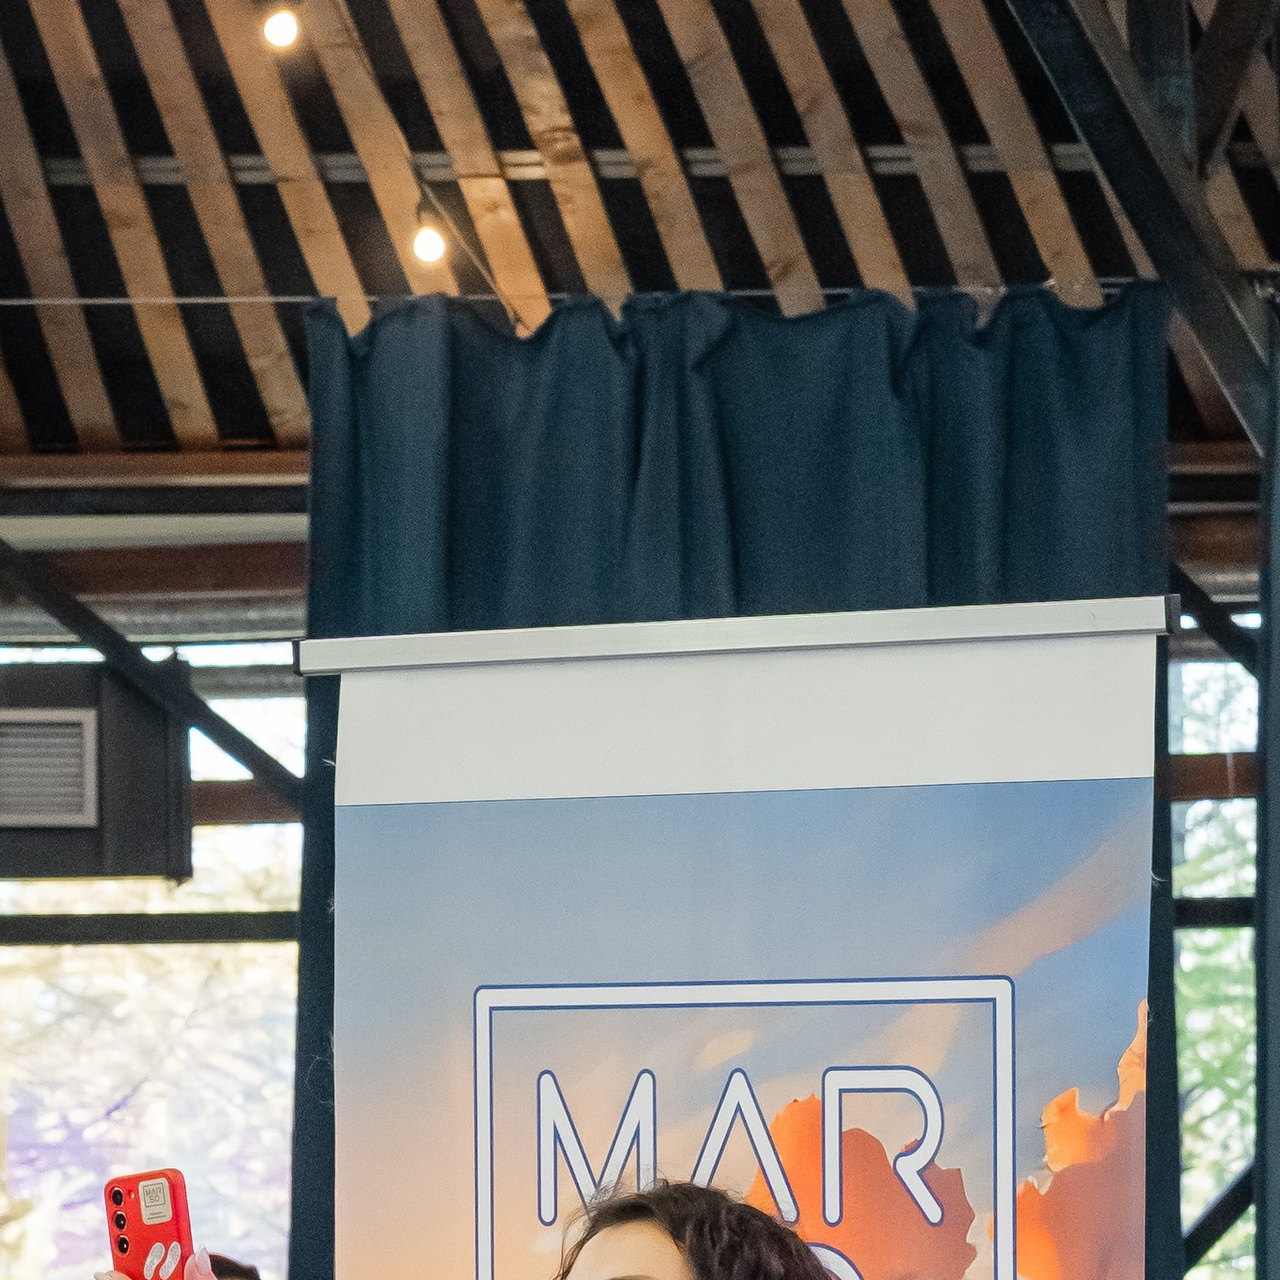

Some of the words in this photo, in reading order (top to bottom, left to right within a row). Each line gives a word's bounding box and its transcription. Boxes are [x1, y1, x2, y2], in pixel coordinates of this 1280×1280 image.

[536, 1065, 946, 1227] MAR
[146, 1186, 163, 1196] MAR
[149, 1195, 160, 1203] SO
